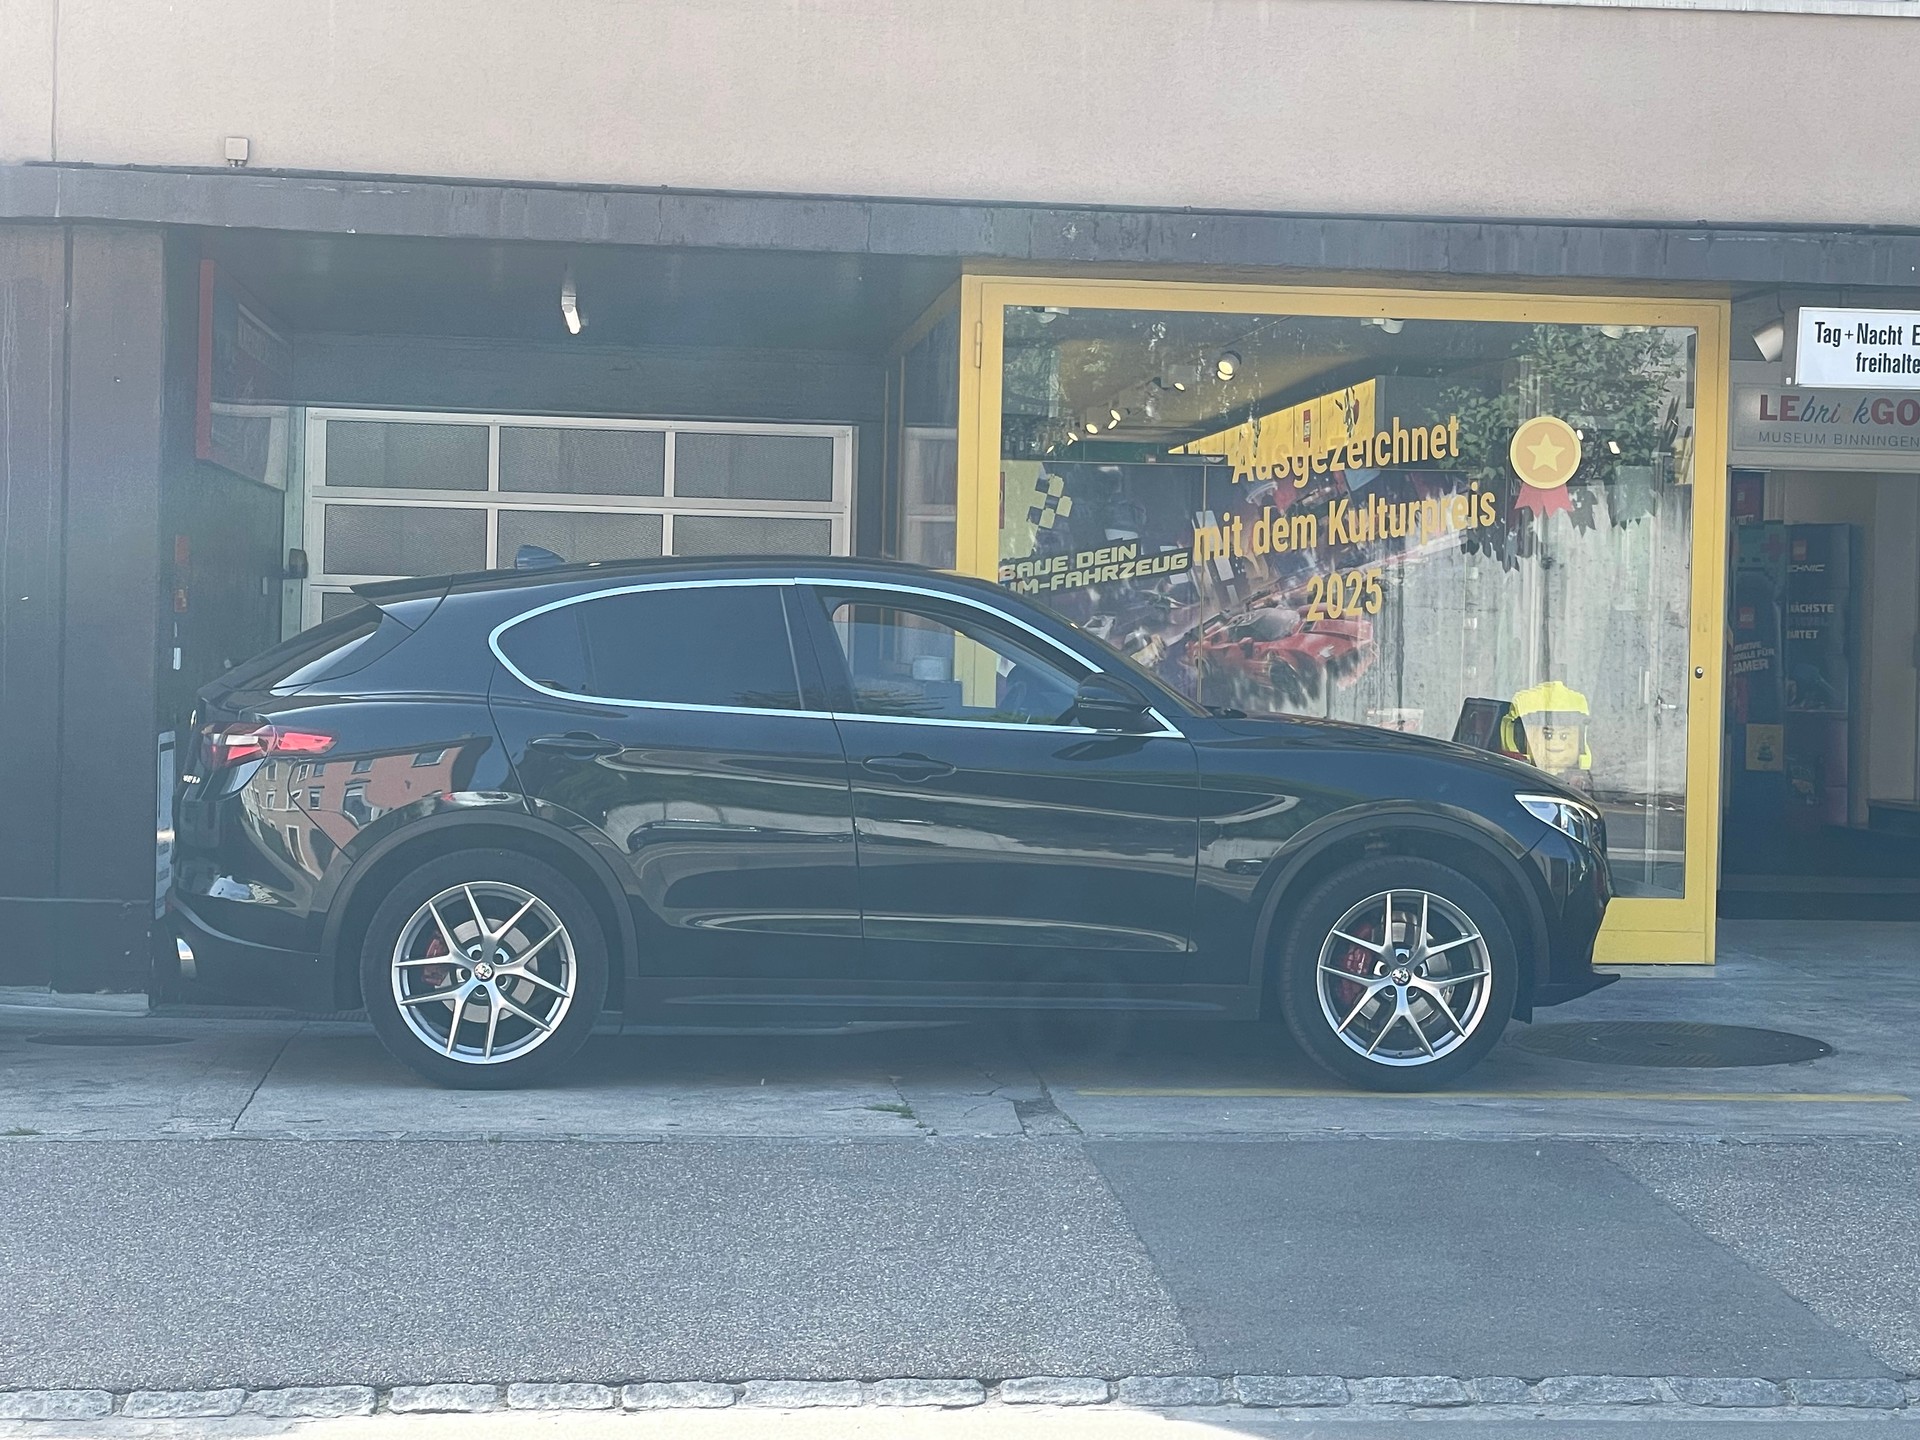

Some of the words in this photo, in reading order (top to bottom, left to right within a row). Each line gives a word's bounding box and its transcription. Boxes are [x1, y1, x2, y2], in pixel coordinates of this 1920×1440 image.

[1231, 415, 1460, 489] Ausgezeichnet
[1759, 431, 1826, 445] MUSEUM
[1834, 433, 1920, 448] BINNINGEN
[1193, 511, 1243, 566] mit
[1253, 506, 1318, 556] dem
[1328, 481, 1497, 547] Kulturpreis
[999, 555, 1069, 582] BAUE
[1077, 543, 1137, 569] DEIN
[1306, 568, 1383, 622] 2025
